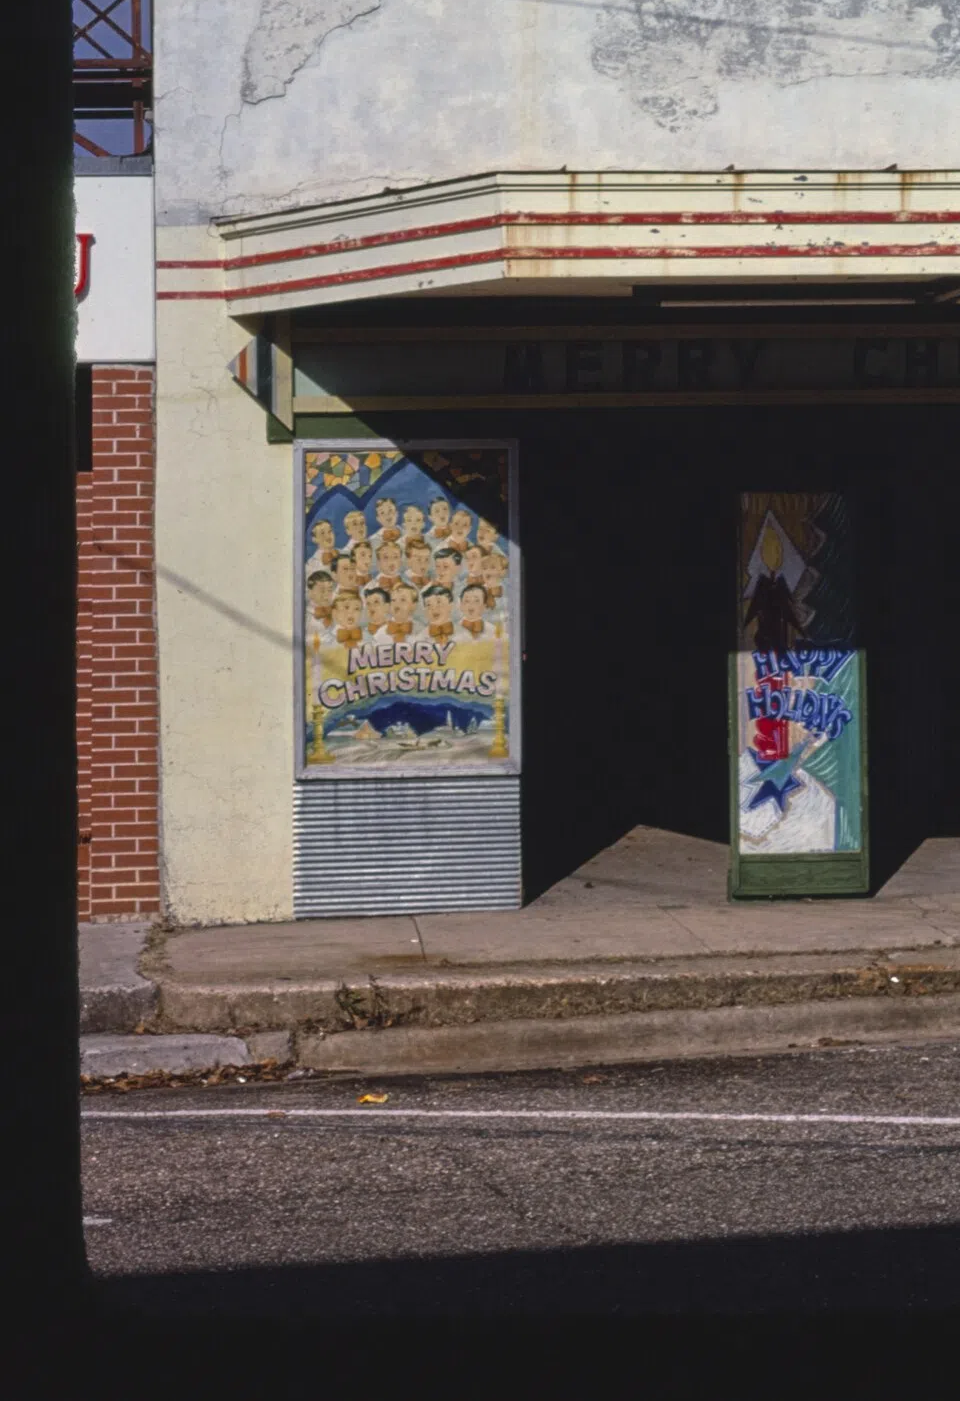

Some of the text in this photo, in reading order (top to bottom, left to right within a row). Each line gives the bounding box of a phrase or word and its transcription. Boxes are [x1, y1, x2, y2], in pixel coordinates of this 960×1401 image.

[503, 340, 764, 392] MERRY
[348, 641, 455, 674] MERRY
[319, 668, 497, 708] CHRISTMAS
